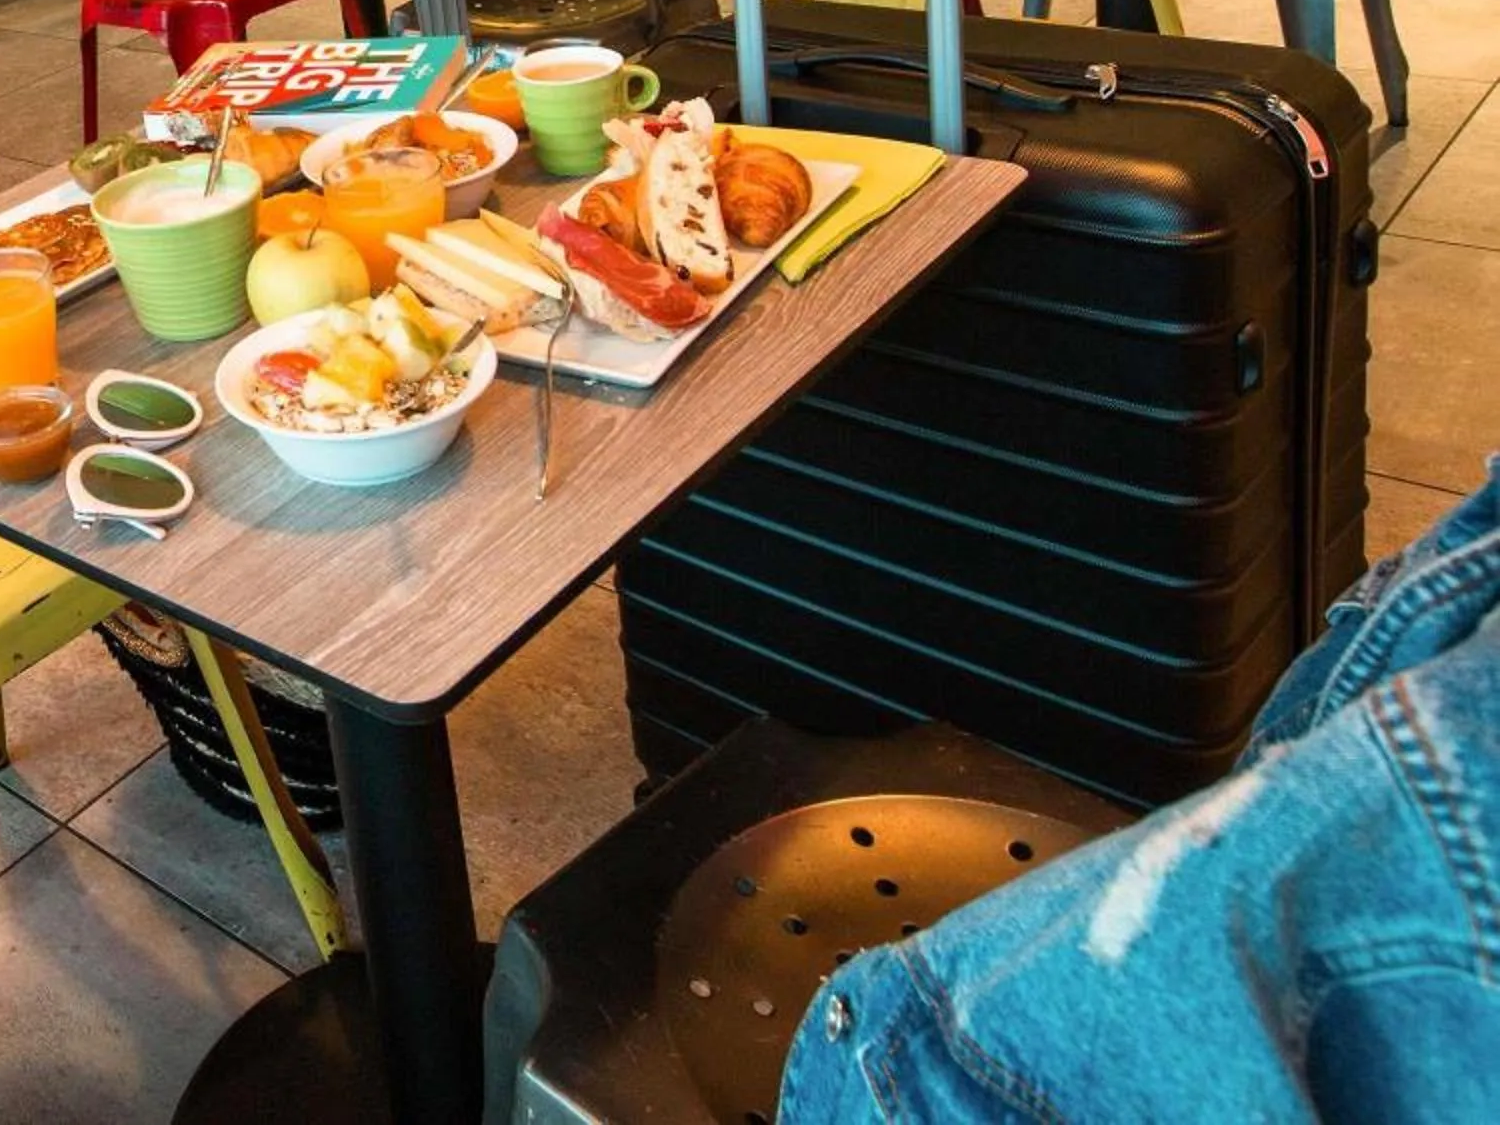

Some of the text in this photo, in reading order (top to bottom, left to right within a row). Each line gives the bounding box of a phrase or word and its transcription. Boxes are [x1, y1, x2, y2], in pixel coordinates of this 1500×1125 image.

[216, 42, 303, 108] TRIP
[283, 42, 371, 92] BIG
[331, 42, 429, 102] THE
